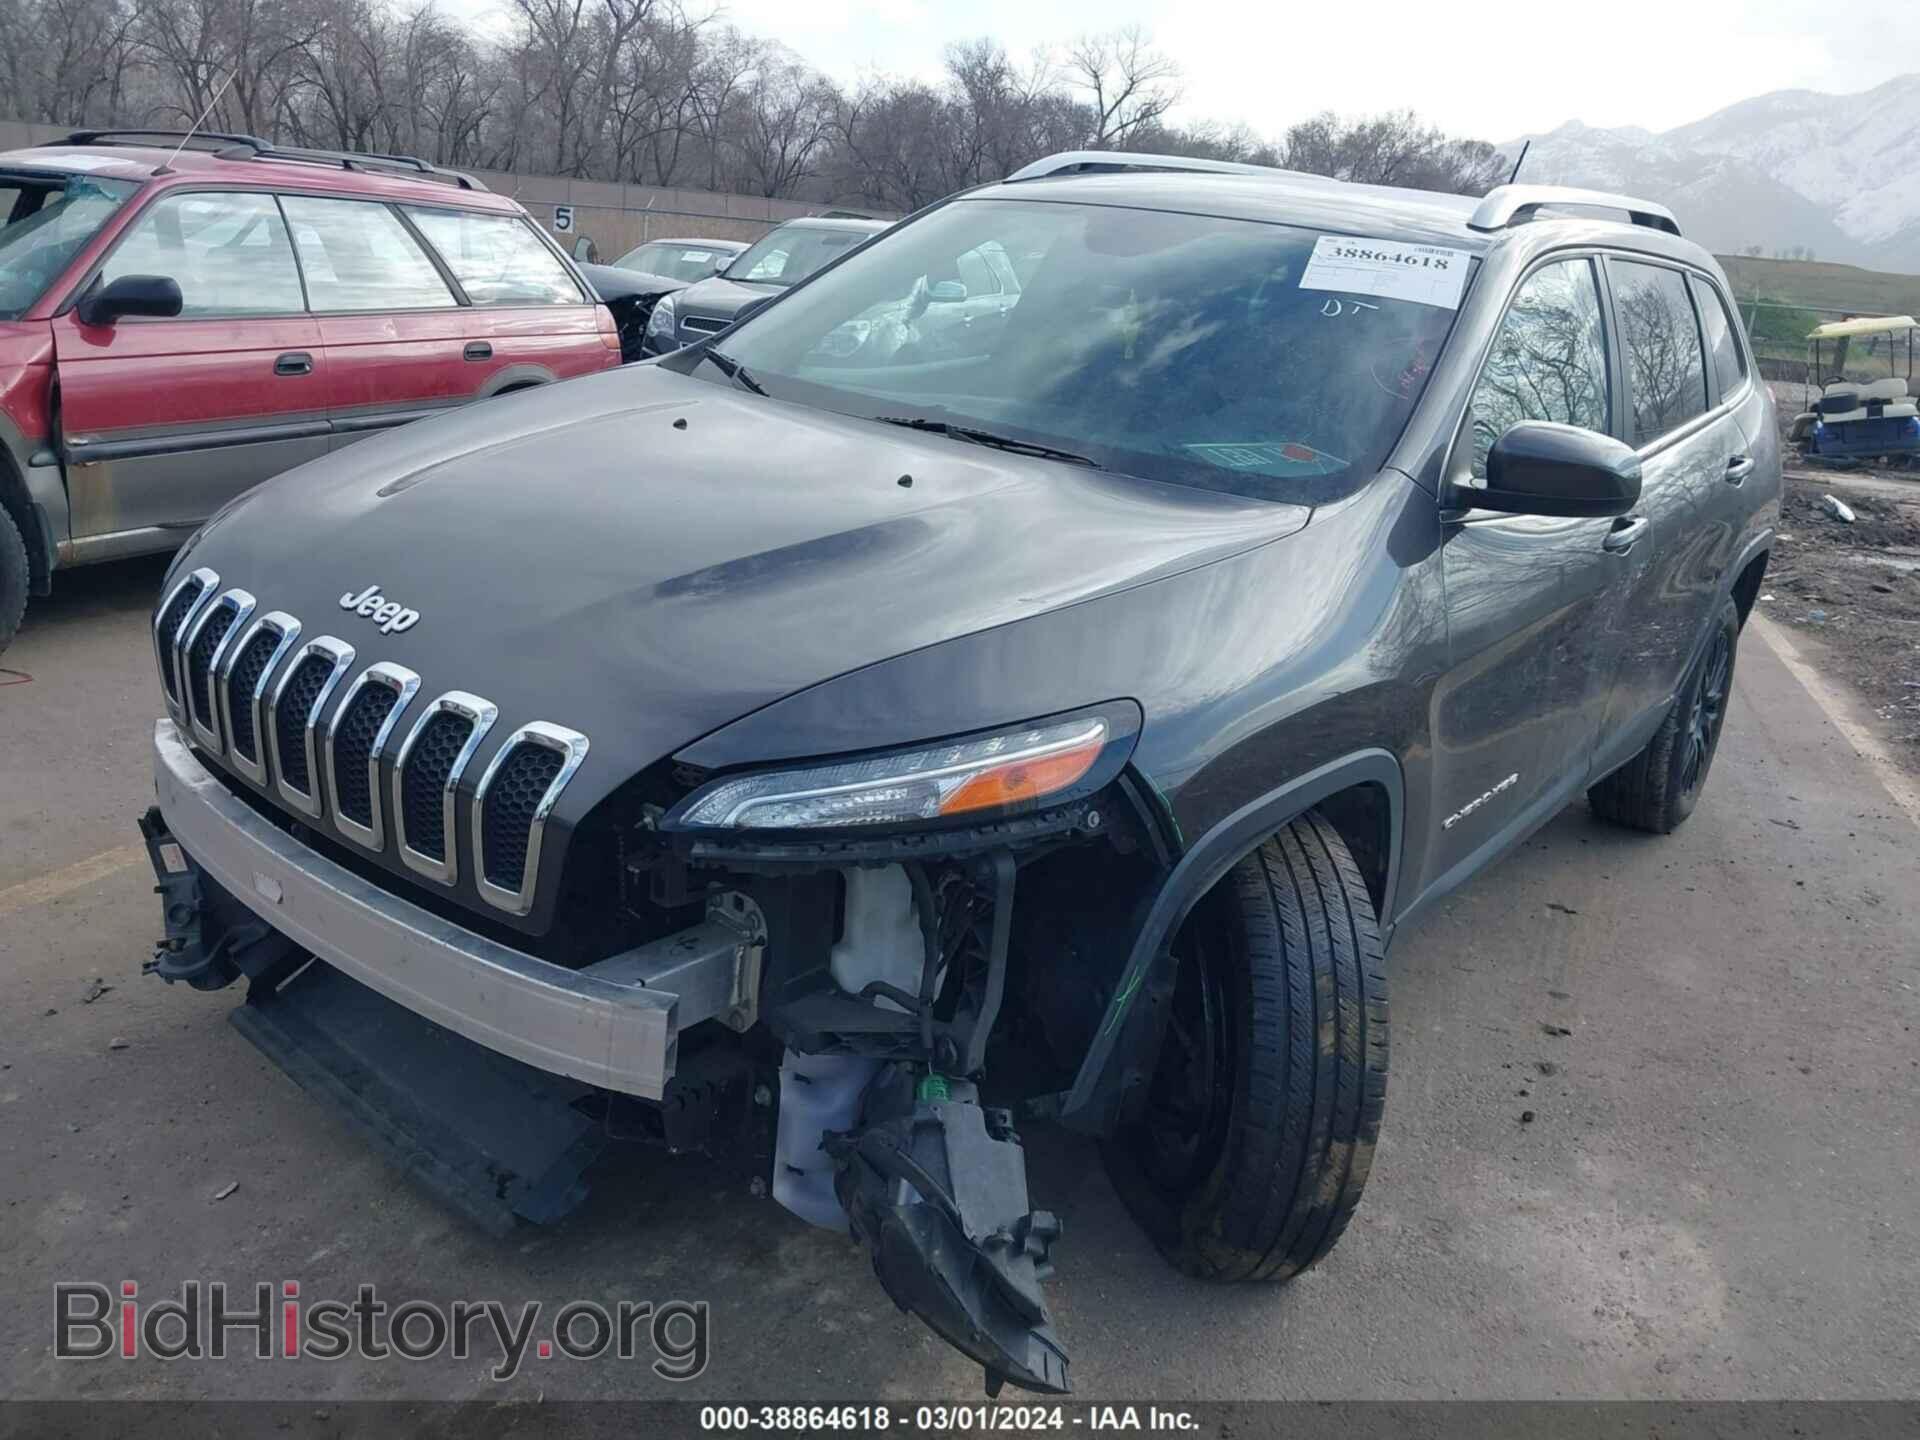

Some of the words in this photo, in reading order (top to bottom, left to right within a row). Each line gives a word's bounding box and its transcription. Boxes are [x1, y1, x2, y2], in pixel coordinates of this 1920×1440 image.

[555, 207, 571, 230] 5
[1328, 246, 1449, 270] 38864618
[339, 584, 421, 635] Jeep
